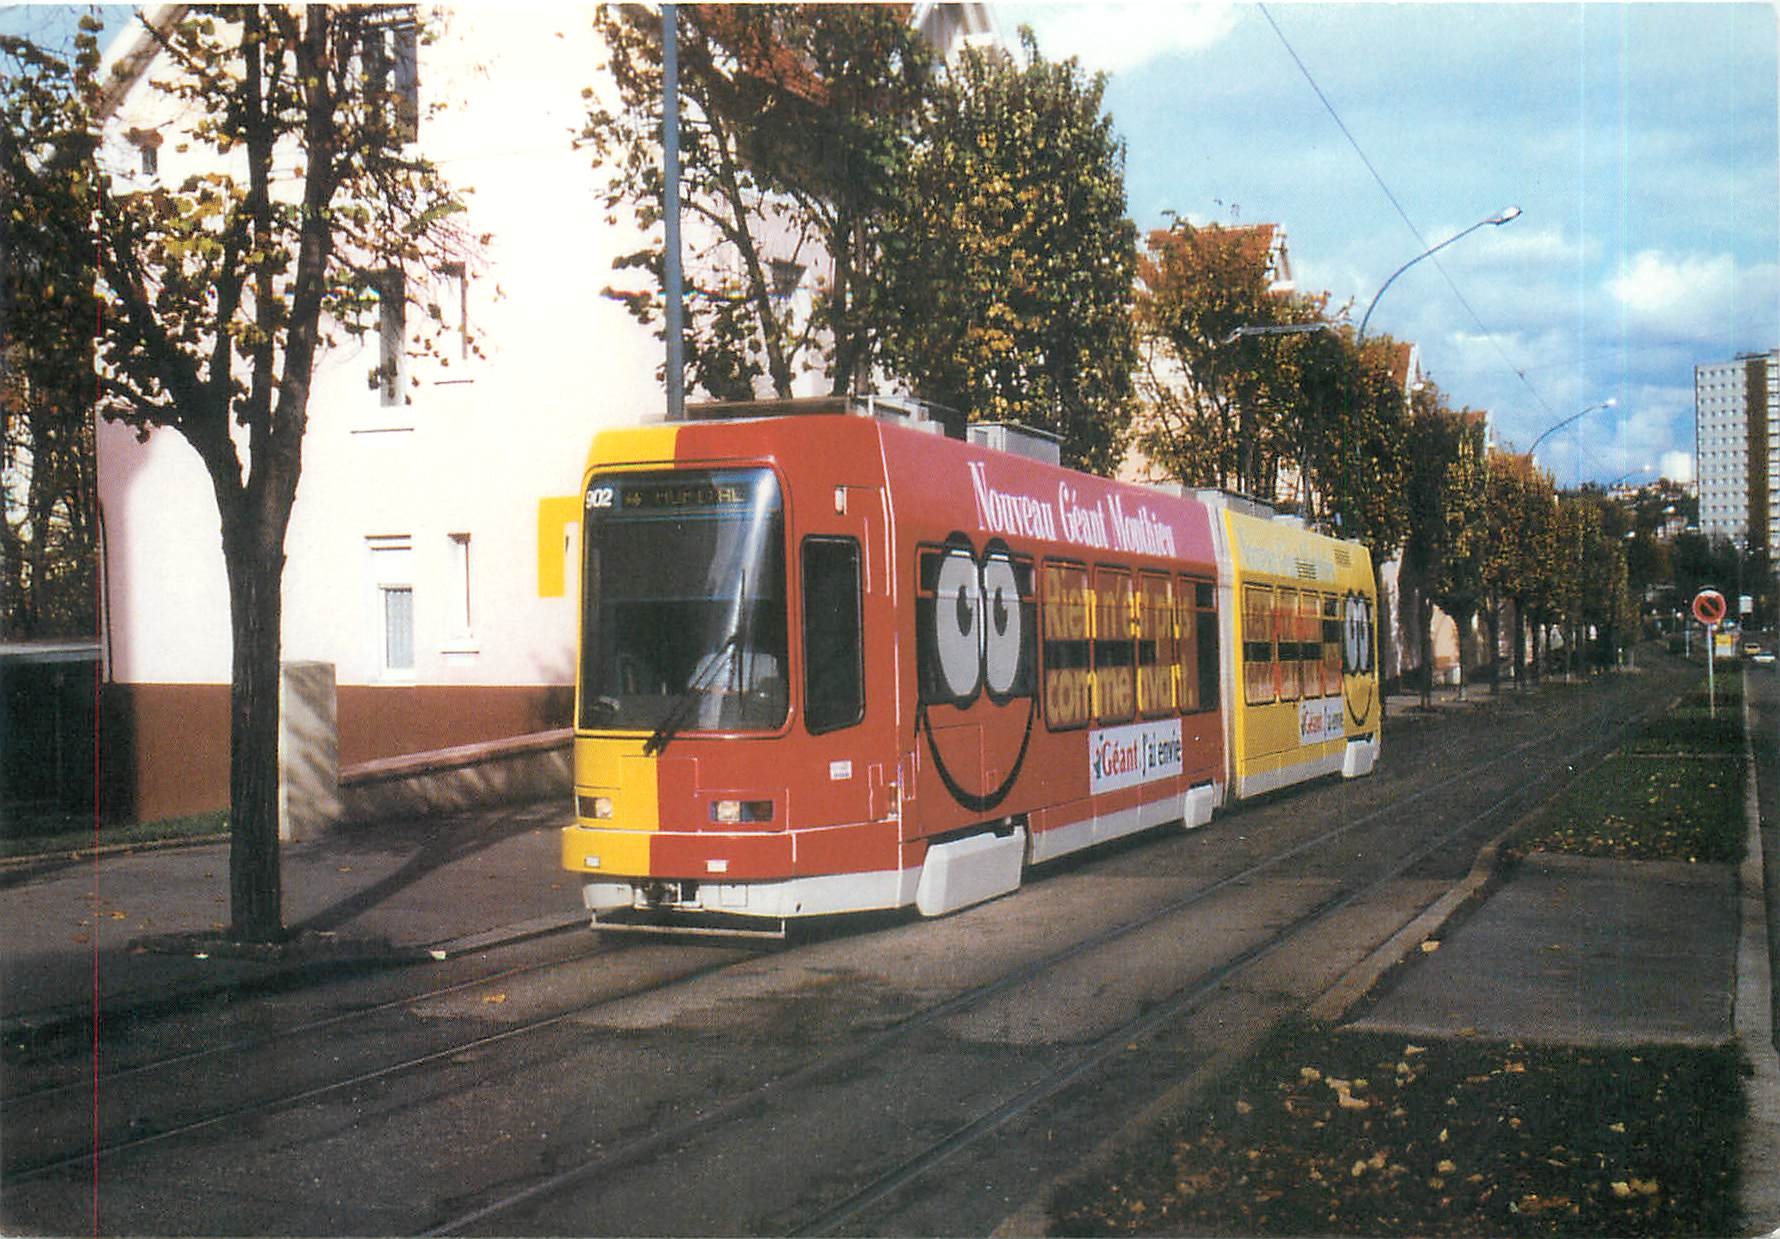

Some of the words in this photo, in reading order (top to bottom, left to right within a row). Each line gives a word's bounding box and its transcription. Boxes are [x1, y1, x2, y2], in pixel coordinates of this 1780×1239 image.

[585, 487, 614, 509] 902
[967, 461, 1057, 542] Nouveau
[1058, 480, 1109, 550] Géant
[1044, 567, 1097, 640] Rien
[1046, 667, 1132, 724] comme
[1102, 739, 1138, 776] Géant
